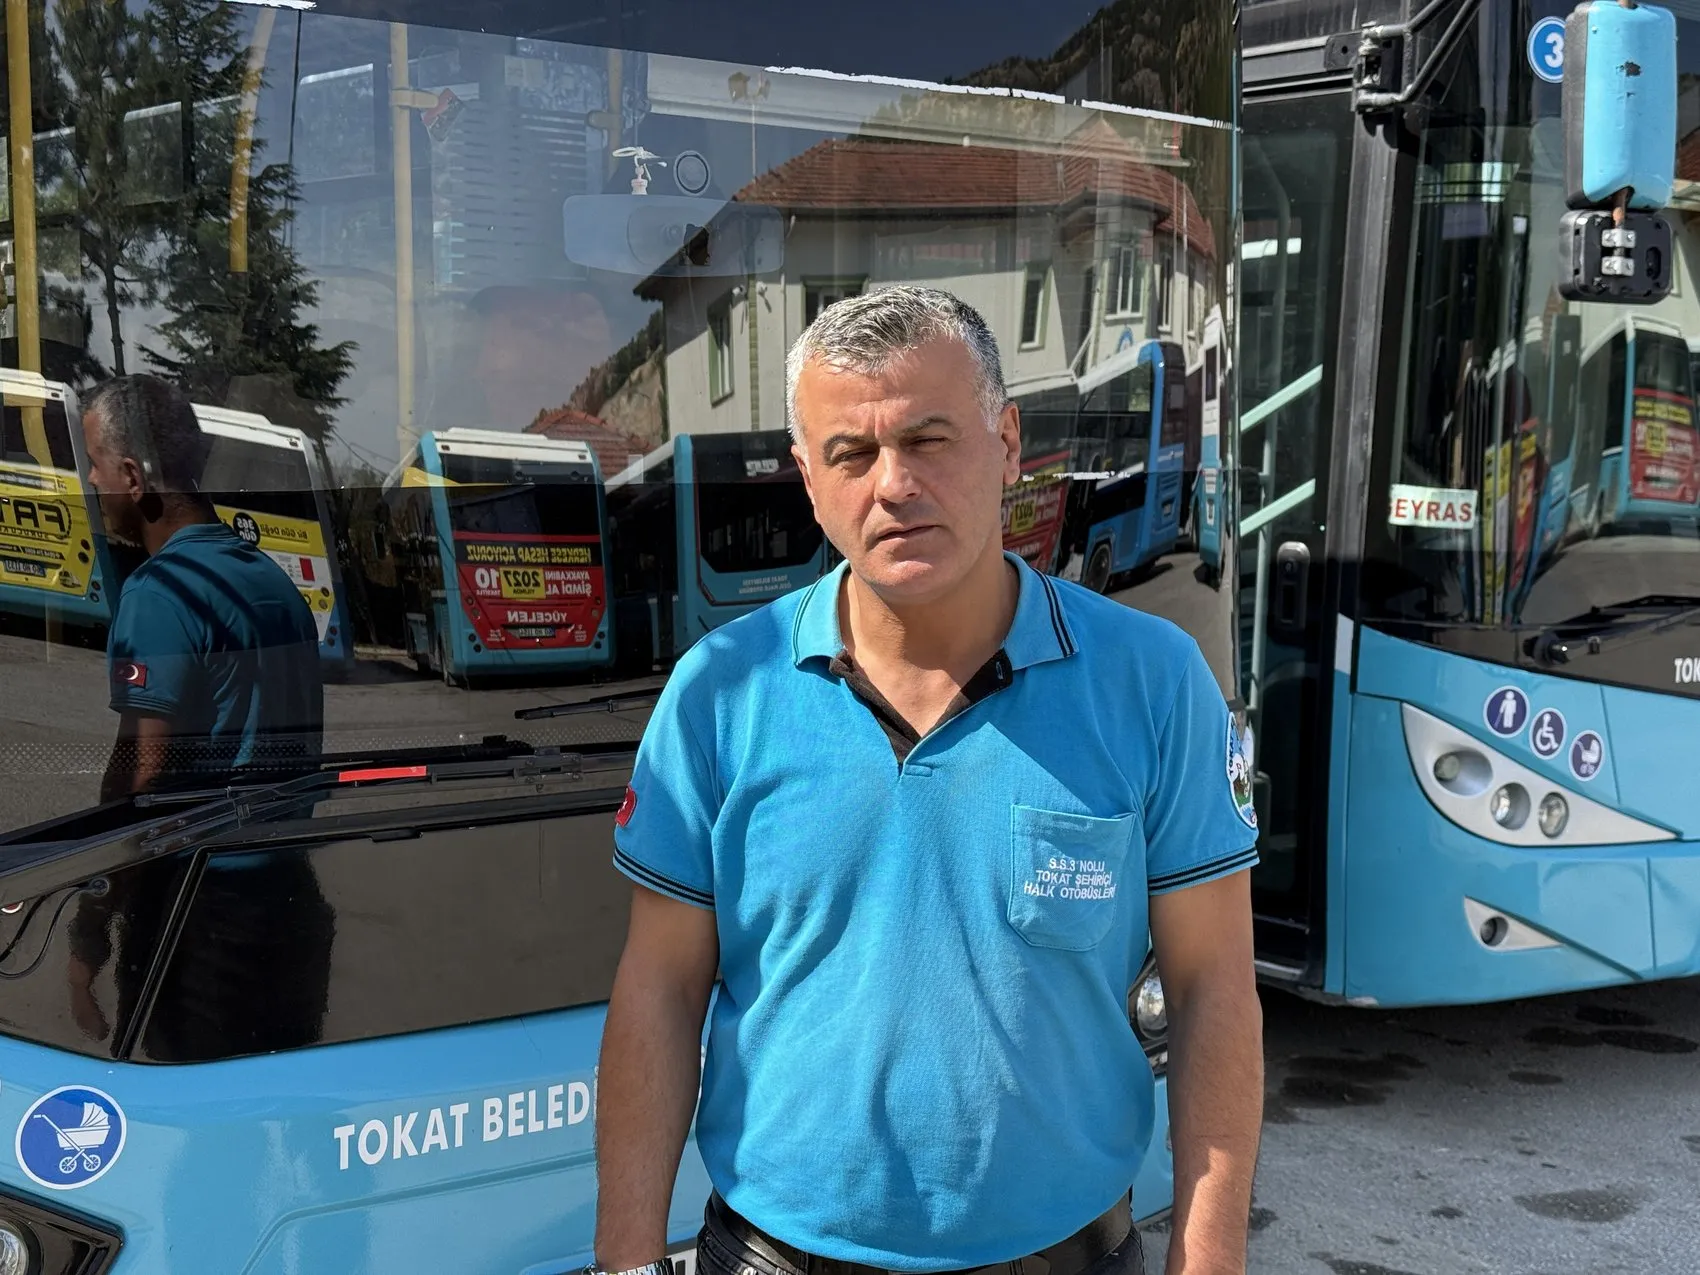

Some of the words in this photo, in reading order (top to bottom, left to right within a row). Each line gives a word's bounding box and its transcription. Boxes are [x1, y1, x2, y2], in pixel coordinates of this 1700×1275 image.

[1544, 33, 1565, 68] 3
[1391, 499, 1472, 523] EYRAS
[1080, 860, 1105, 872] NOLU
[1036, 870, 1073, 884] TOKAT
[1023, 880, 1056, 898] HALK
[333, 1101, 470, 1170] TOKAT
[483, 1079, 598, 1141] BELED
